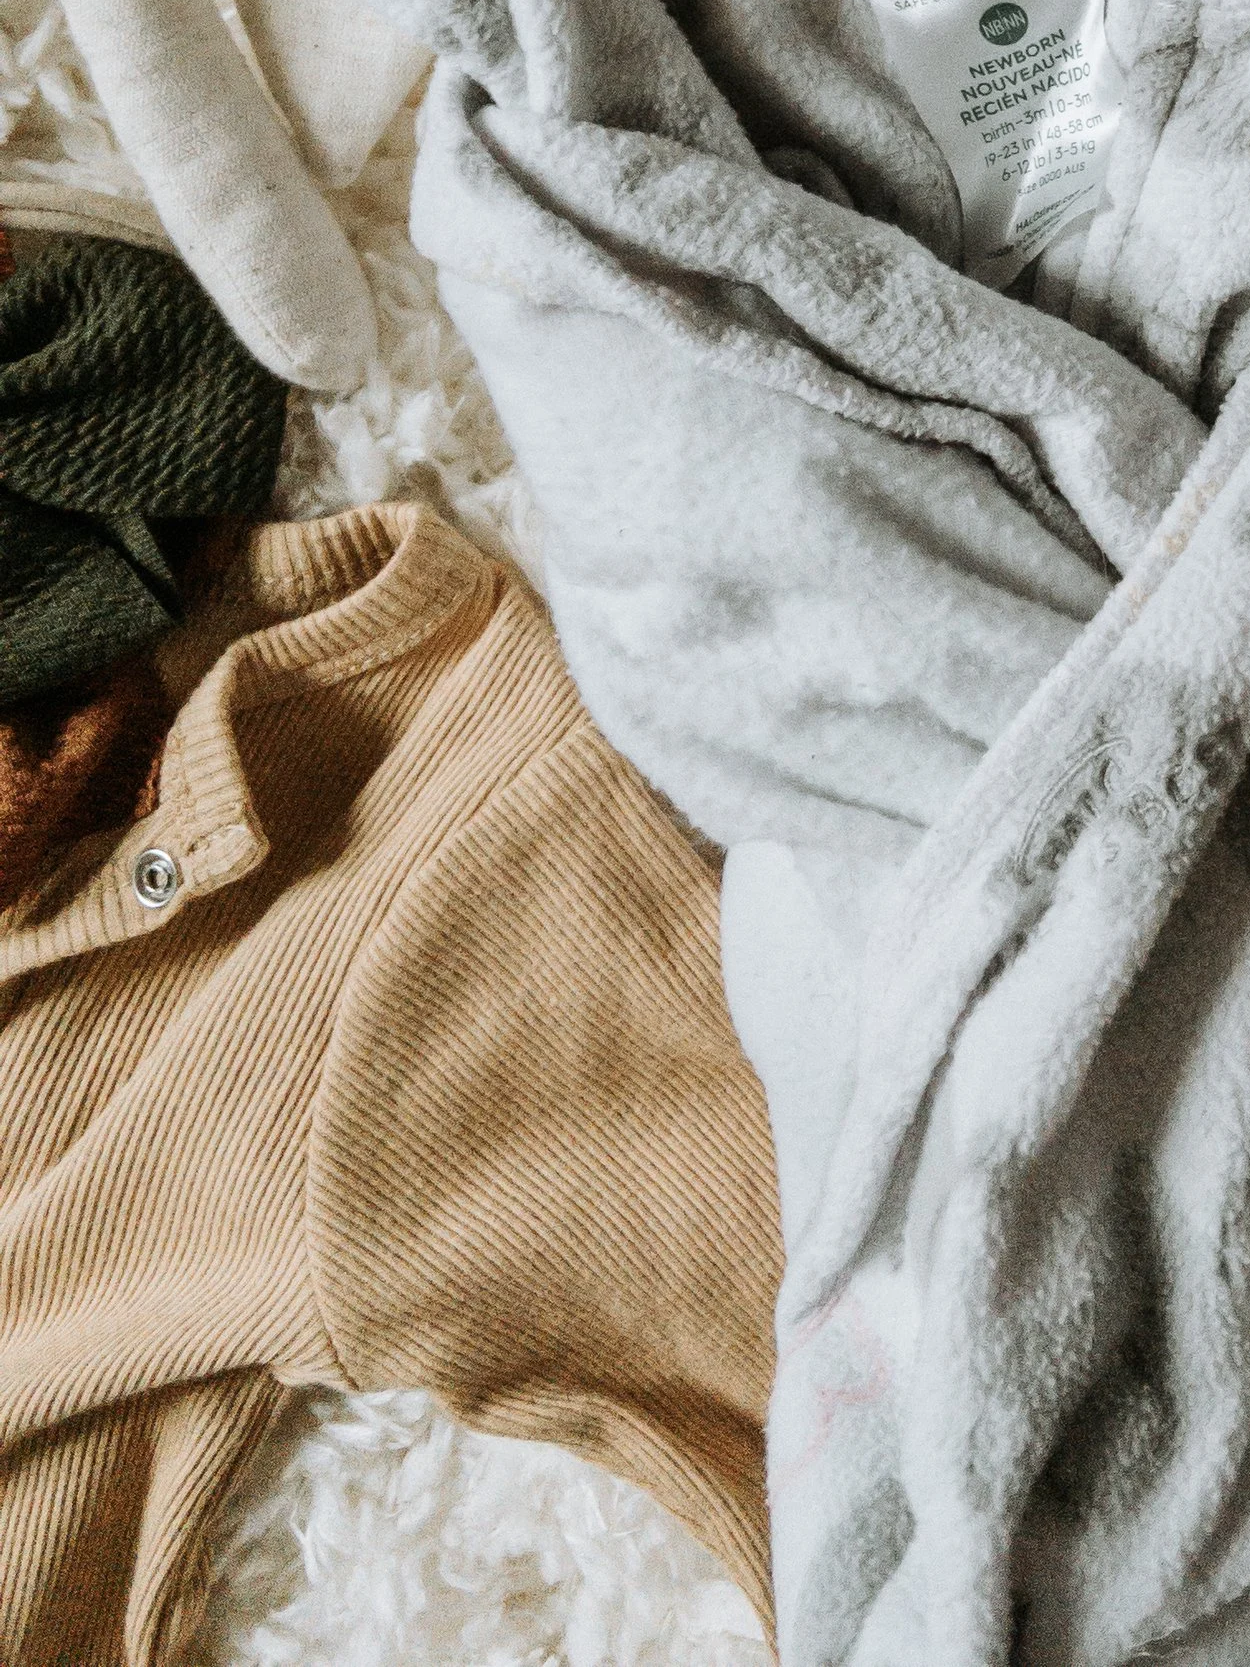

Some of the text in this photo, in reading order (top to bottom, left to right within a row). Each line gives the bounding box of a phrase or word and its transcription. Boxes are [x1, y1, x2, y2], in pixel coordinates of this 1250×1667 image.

[960, 39, 1084, 103] NOUVEAU-NÉ
[968, 28, 1066, 79] NEWBORN
[959, 62, 1091, 127] RECIÉN NACIDO
[984, 141, 1020, 168] 19-23
[1021, 138, 1036, 151] in
[1046, 118, 1084, 140] 48-58
[1085, 114, 1104, 129] cm
[1001, 159, 1032, 182] 6-12
[1034, 155, 1046, 169] lb
[1055, 141, 1079, 160] 3-5
[1081, 139, 1097, 154] kg
